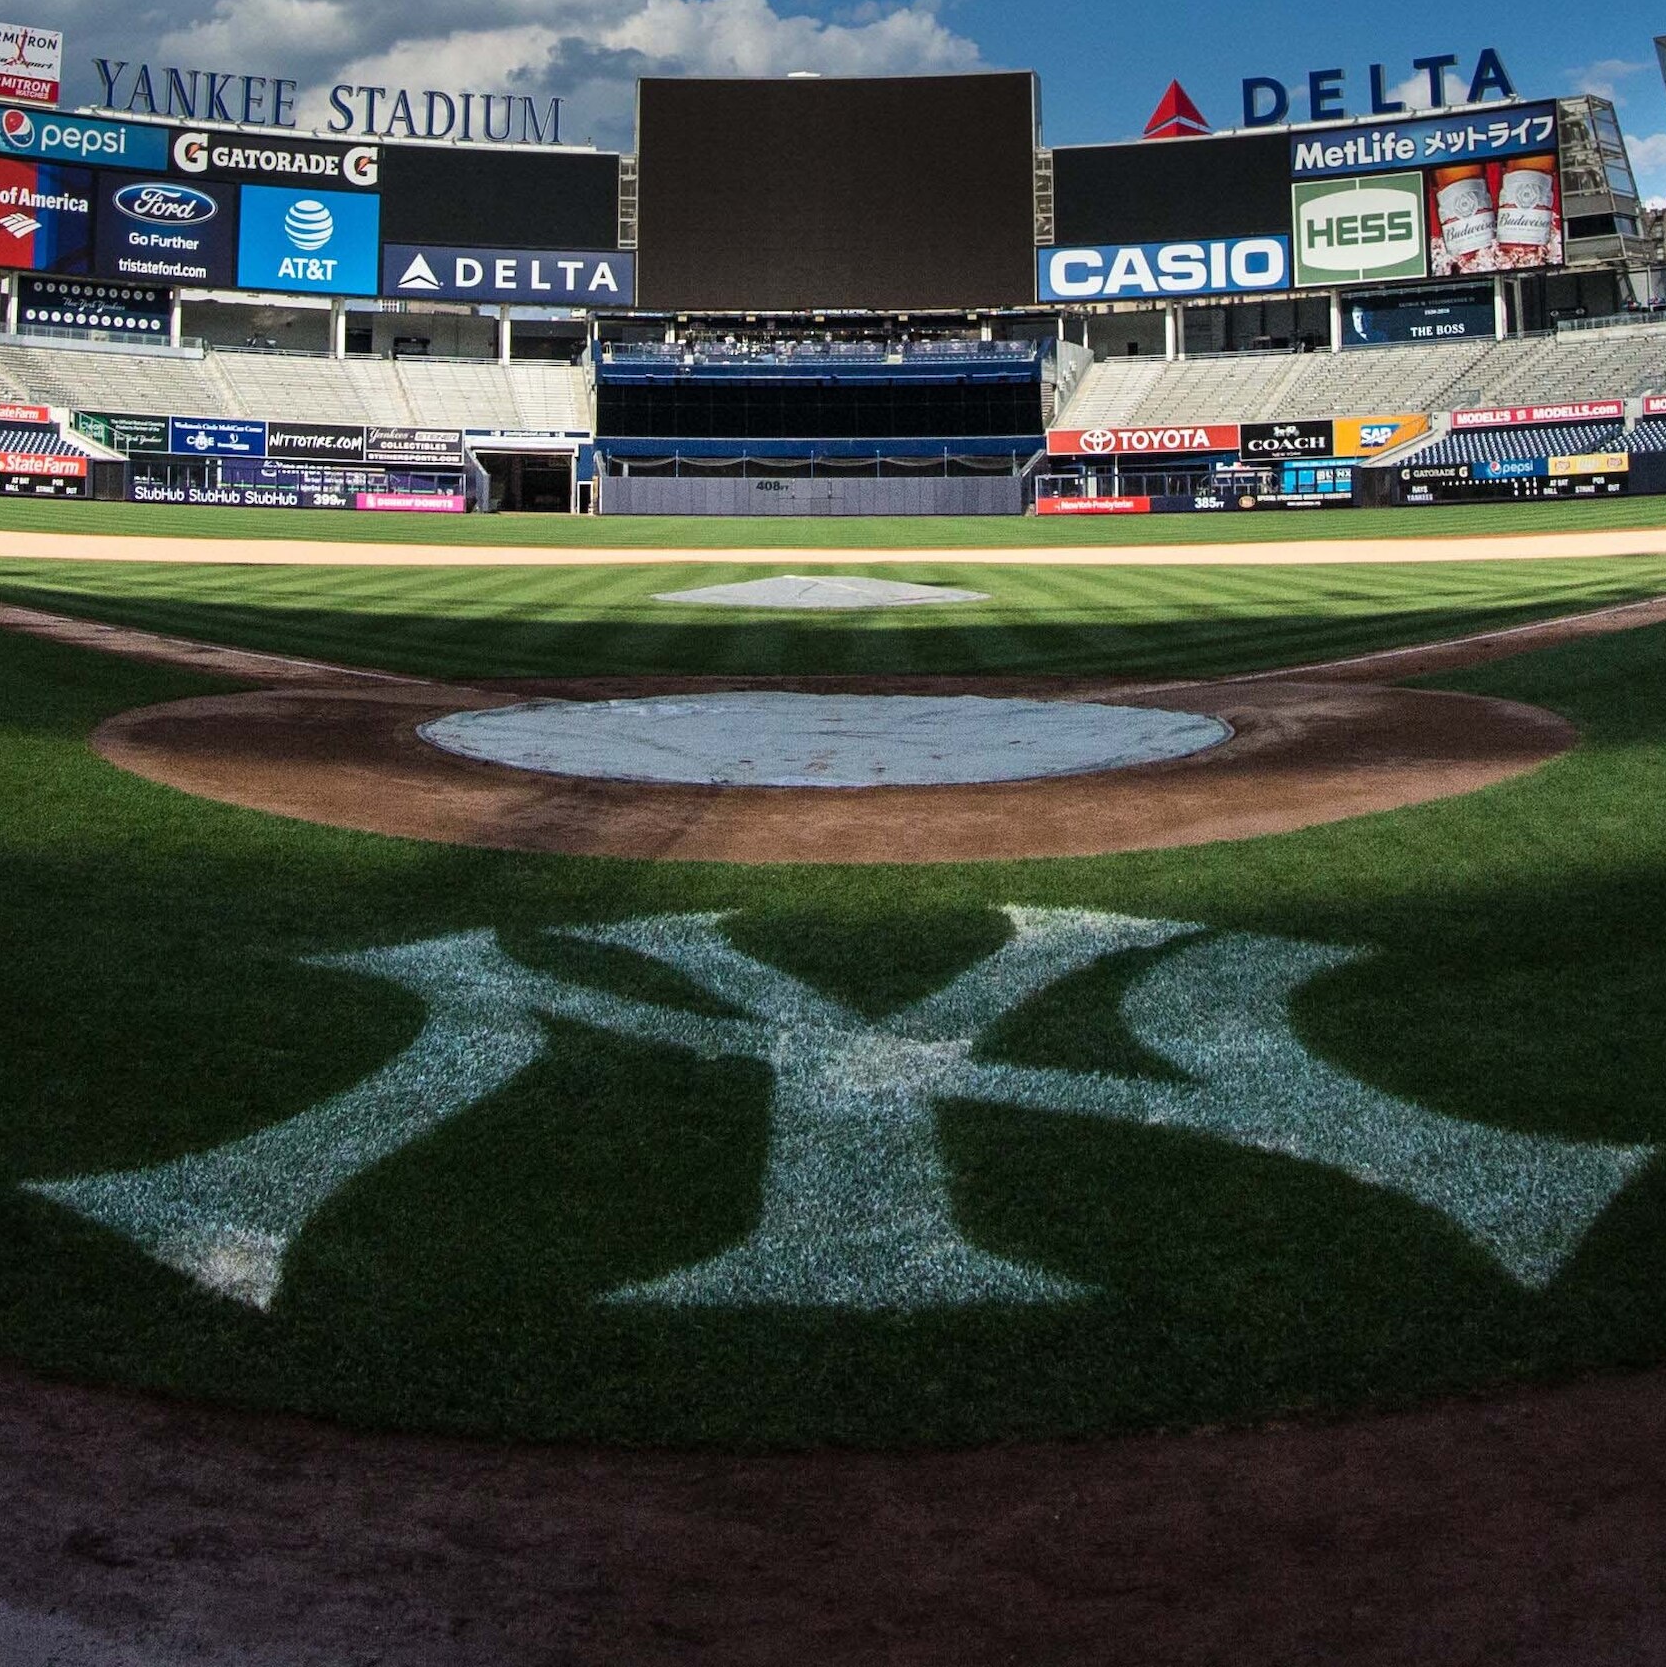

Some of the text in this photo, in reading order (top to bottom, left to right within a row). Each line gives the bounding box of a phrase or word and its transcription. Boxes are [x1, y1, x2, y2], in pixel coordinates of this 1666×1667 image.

[1242, 47, 1516, 127] DELTA
[92, 58, 565, 145] YANKEE STADIUM
[40, 123, 126, 157] pepsi
[1425, 116, 1553, 156] メットライフ
[212, 147, 339, 176] GATORADE
[1294, 132, 1414, 171] MetLife
[0, 186, 18, 204] of
[17, 189, 89, 213] America
[134, 187, 197, 219] Ford
[1307, 210, 1413, 249] HESS
[129, 232, 199, 250] Go Further
[118, 258, 206, 279] tristateford.com
[278, 257, 337, 281] AT&T
[455, 257, 618, 291] DELTA
[1049, 238, 1285, 296] CASIO
[1410, 323, 1465, 337] THE BOSS
[1456, 404, 1618, 425] MODELL'S MODELLS.com
[269, 432, 363, 451] NITTOTIRE.COM
[381, 442, 447, 451] COLLECTIBLES
[1118, 429, 1210, 449] TOYOTA
[1248, 437, 1325, 451] COACH
[1360, 428, 1392, 445] SAP
[1413, 469, 1455, 478] GATORADE
[1503, 460, 1533, 474] pepsi
[135, 486, 297, 506] StubHub StubHub StubHub
[1407, 493, 1433, 501] YANKEES
